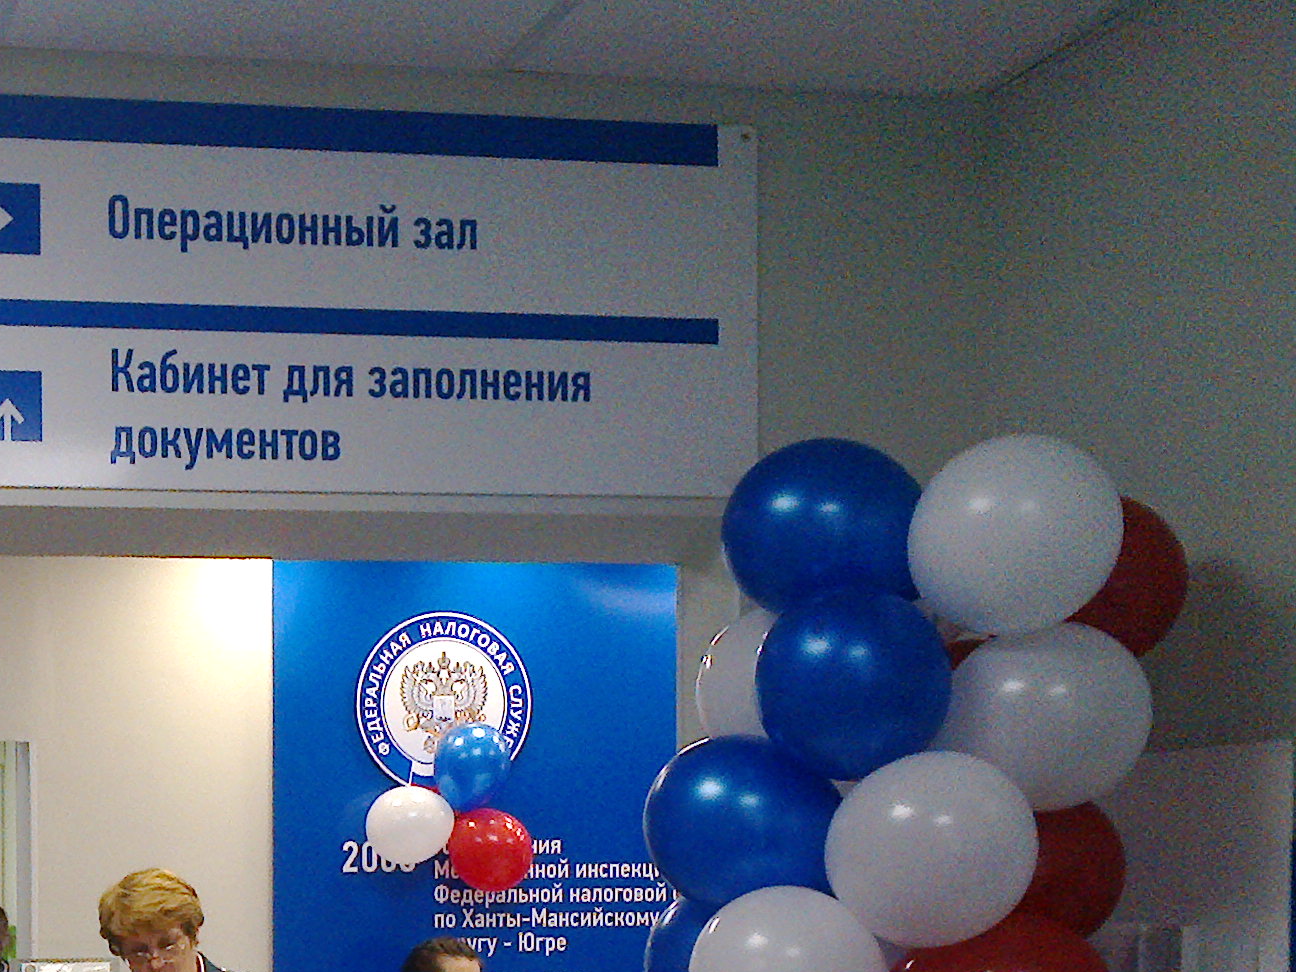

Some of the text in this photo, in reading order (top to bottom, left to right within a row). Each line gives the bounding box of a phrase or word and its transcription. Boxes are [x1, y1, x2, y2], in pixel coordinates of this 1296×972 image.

[107, 193, 478, 254] Операционный зал
[111, 347, 591, 402] Кабинет для заполнения
[110, 426, 341, 470] документов
[364, 632, 412, 756] ФЕДЕРАЛЬНАЯ
[420, 621, 515, 676] НАЛОГОВАЯ
[342, 840, 416, 874] 20
[434, 882, 563, 908] Федеральной
[570, 882, 667, 903] налоговой
[434, 907, 660, 929] по Ханты-Мансийскому
[518, 931, 567, 953] Югре
